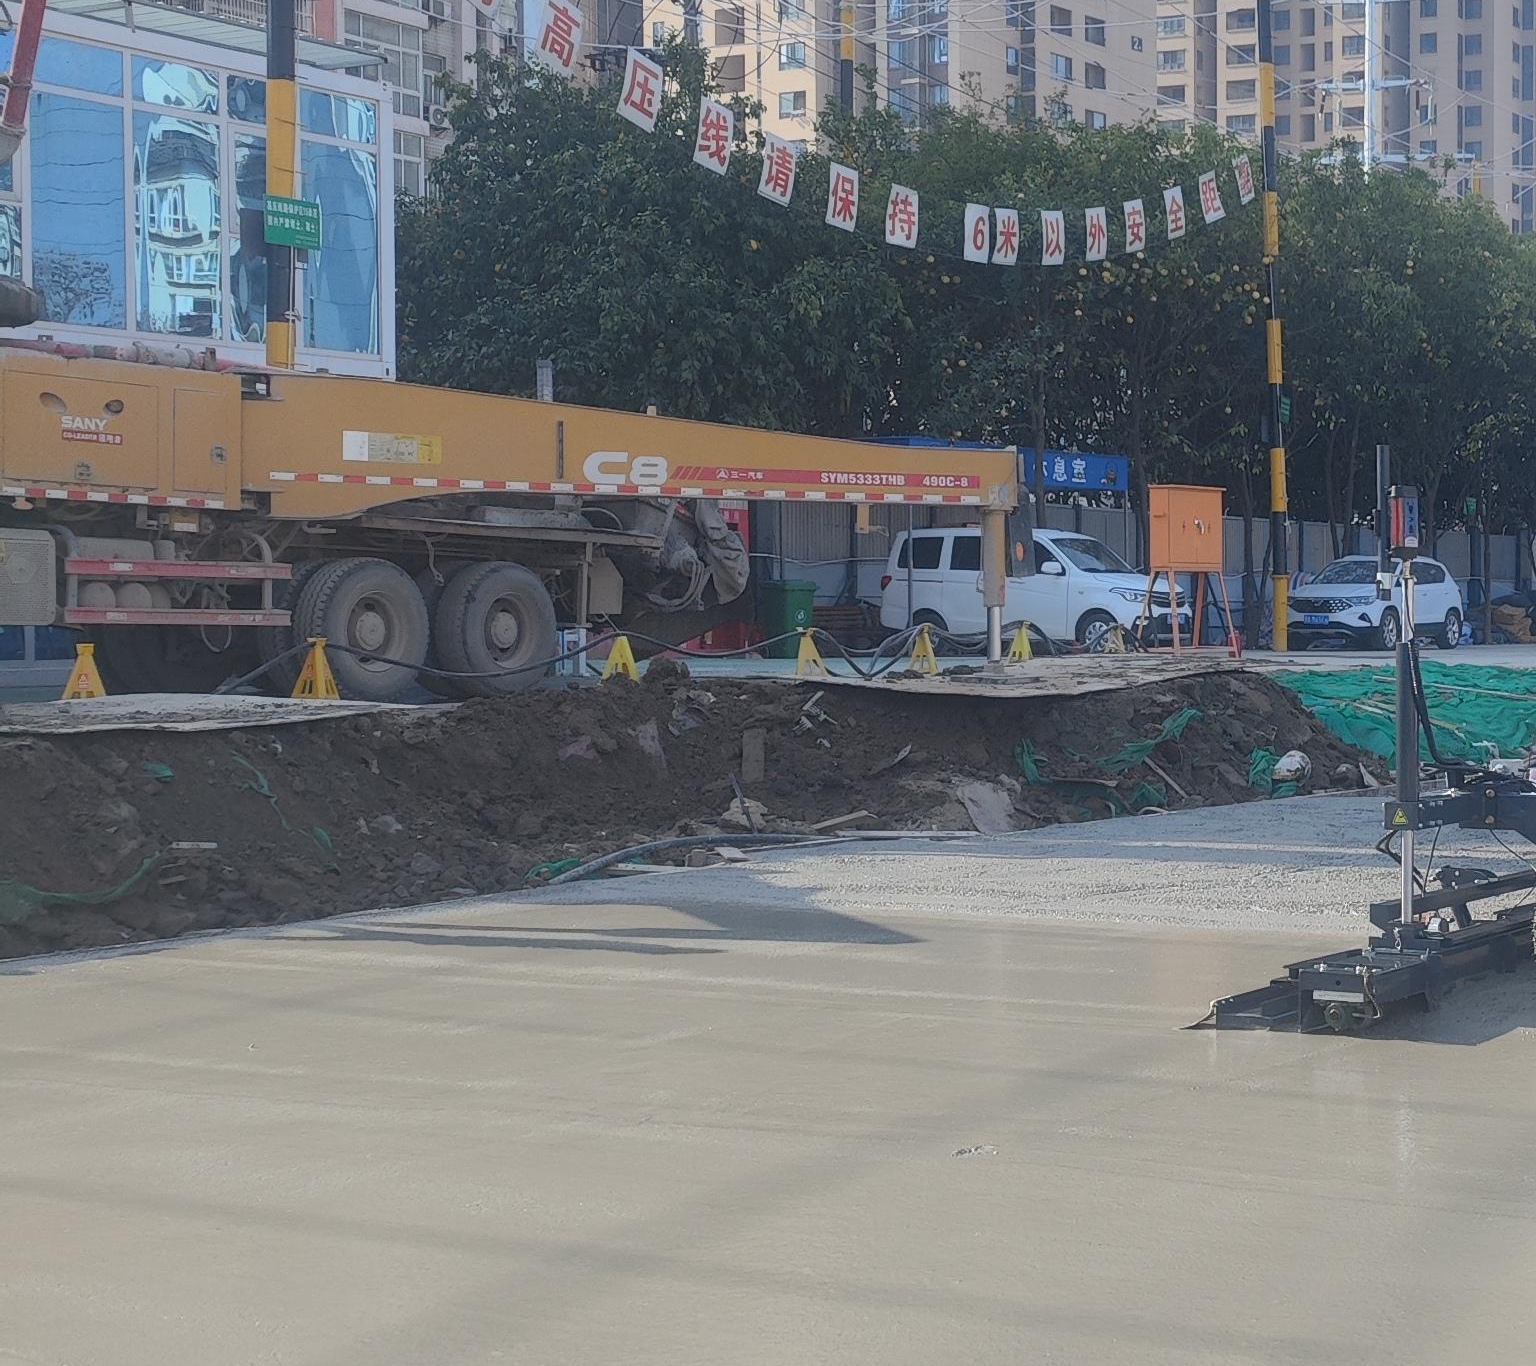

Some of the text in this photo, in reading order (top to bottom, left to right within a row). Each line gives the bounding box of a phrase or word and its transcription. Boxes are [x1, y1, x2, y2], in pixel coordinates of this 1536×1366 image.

[61, 415, 107, 430] SANY
[583, 451, 668, 485] C8
[730, 470, 763, 480] 三一汽车
[820, 472, 969, 487] SYM5333THB 490C-8
